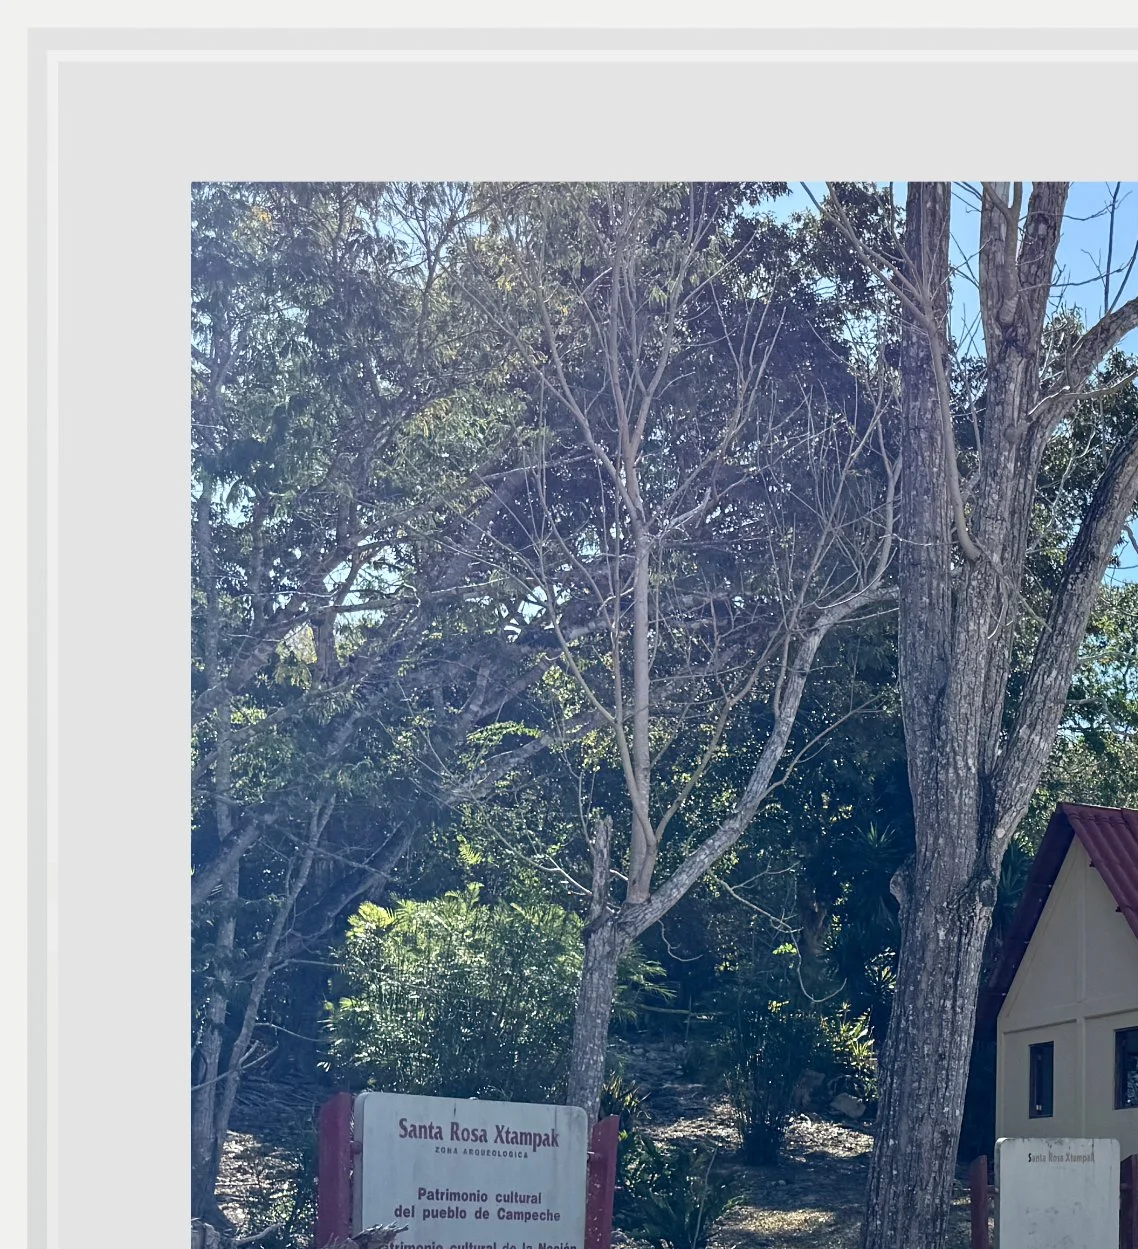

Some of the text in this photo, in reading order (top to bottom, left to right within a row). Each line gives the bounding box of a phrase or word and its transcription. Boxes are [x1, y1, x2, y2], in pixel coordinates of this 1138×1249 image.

[399, 1118, 559, 1152] Santa Rosa Xtampak
[463, 1149, 529, 1159] ARQUEOLOGICA
[418, 1187, 542, 1204] Patrimonio cultural
[394, 1205, 561, 1222] del pueblo de Campeche
